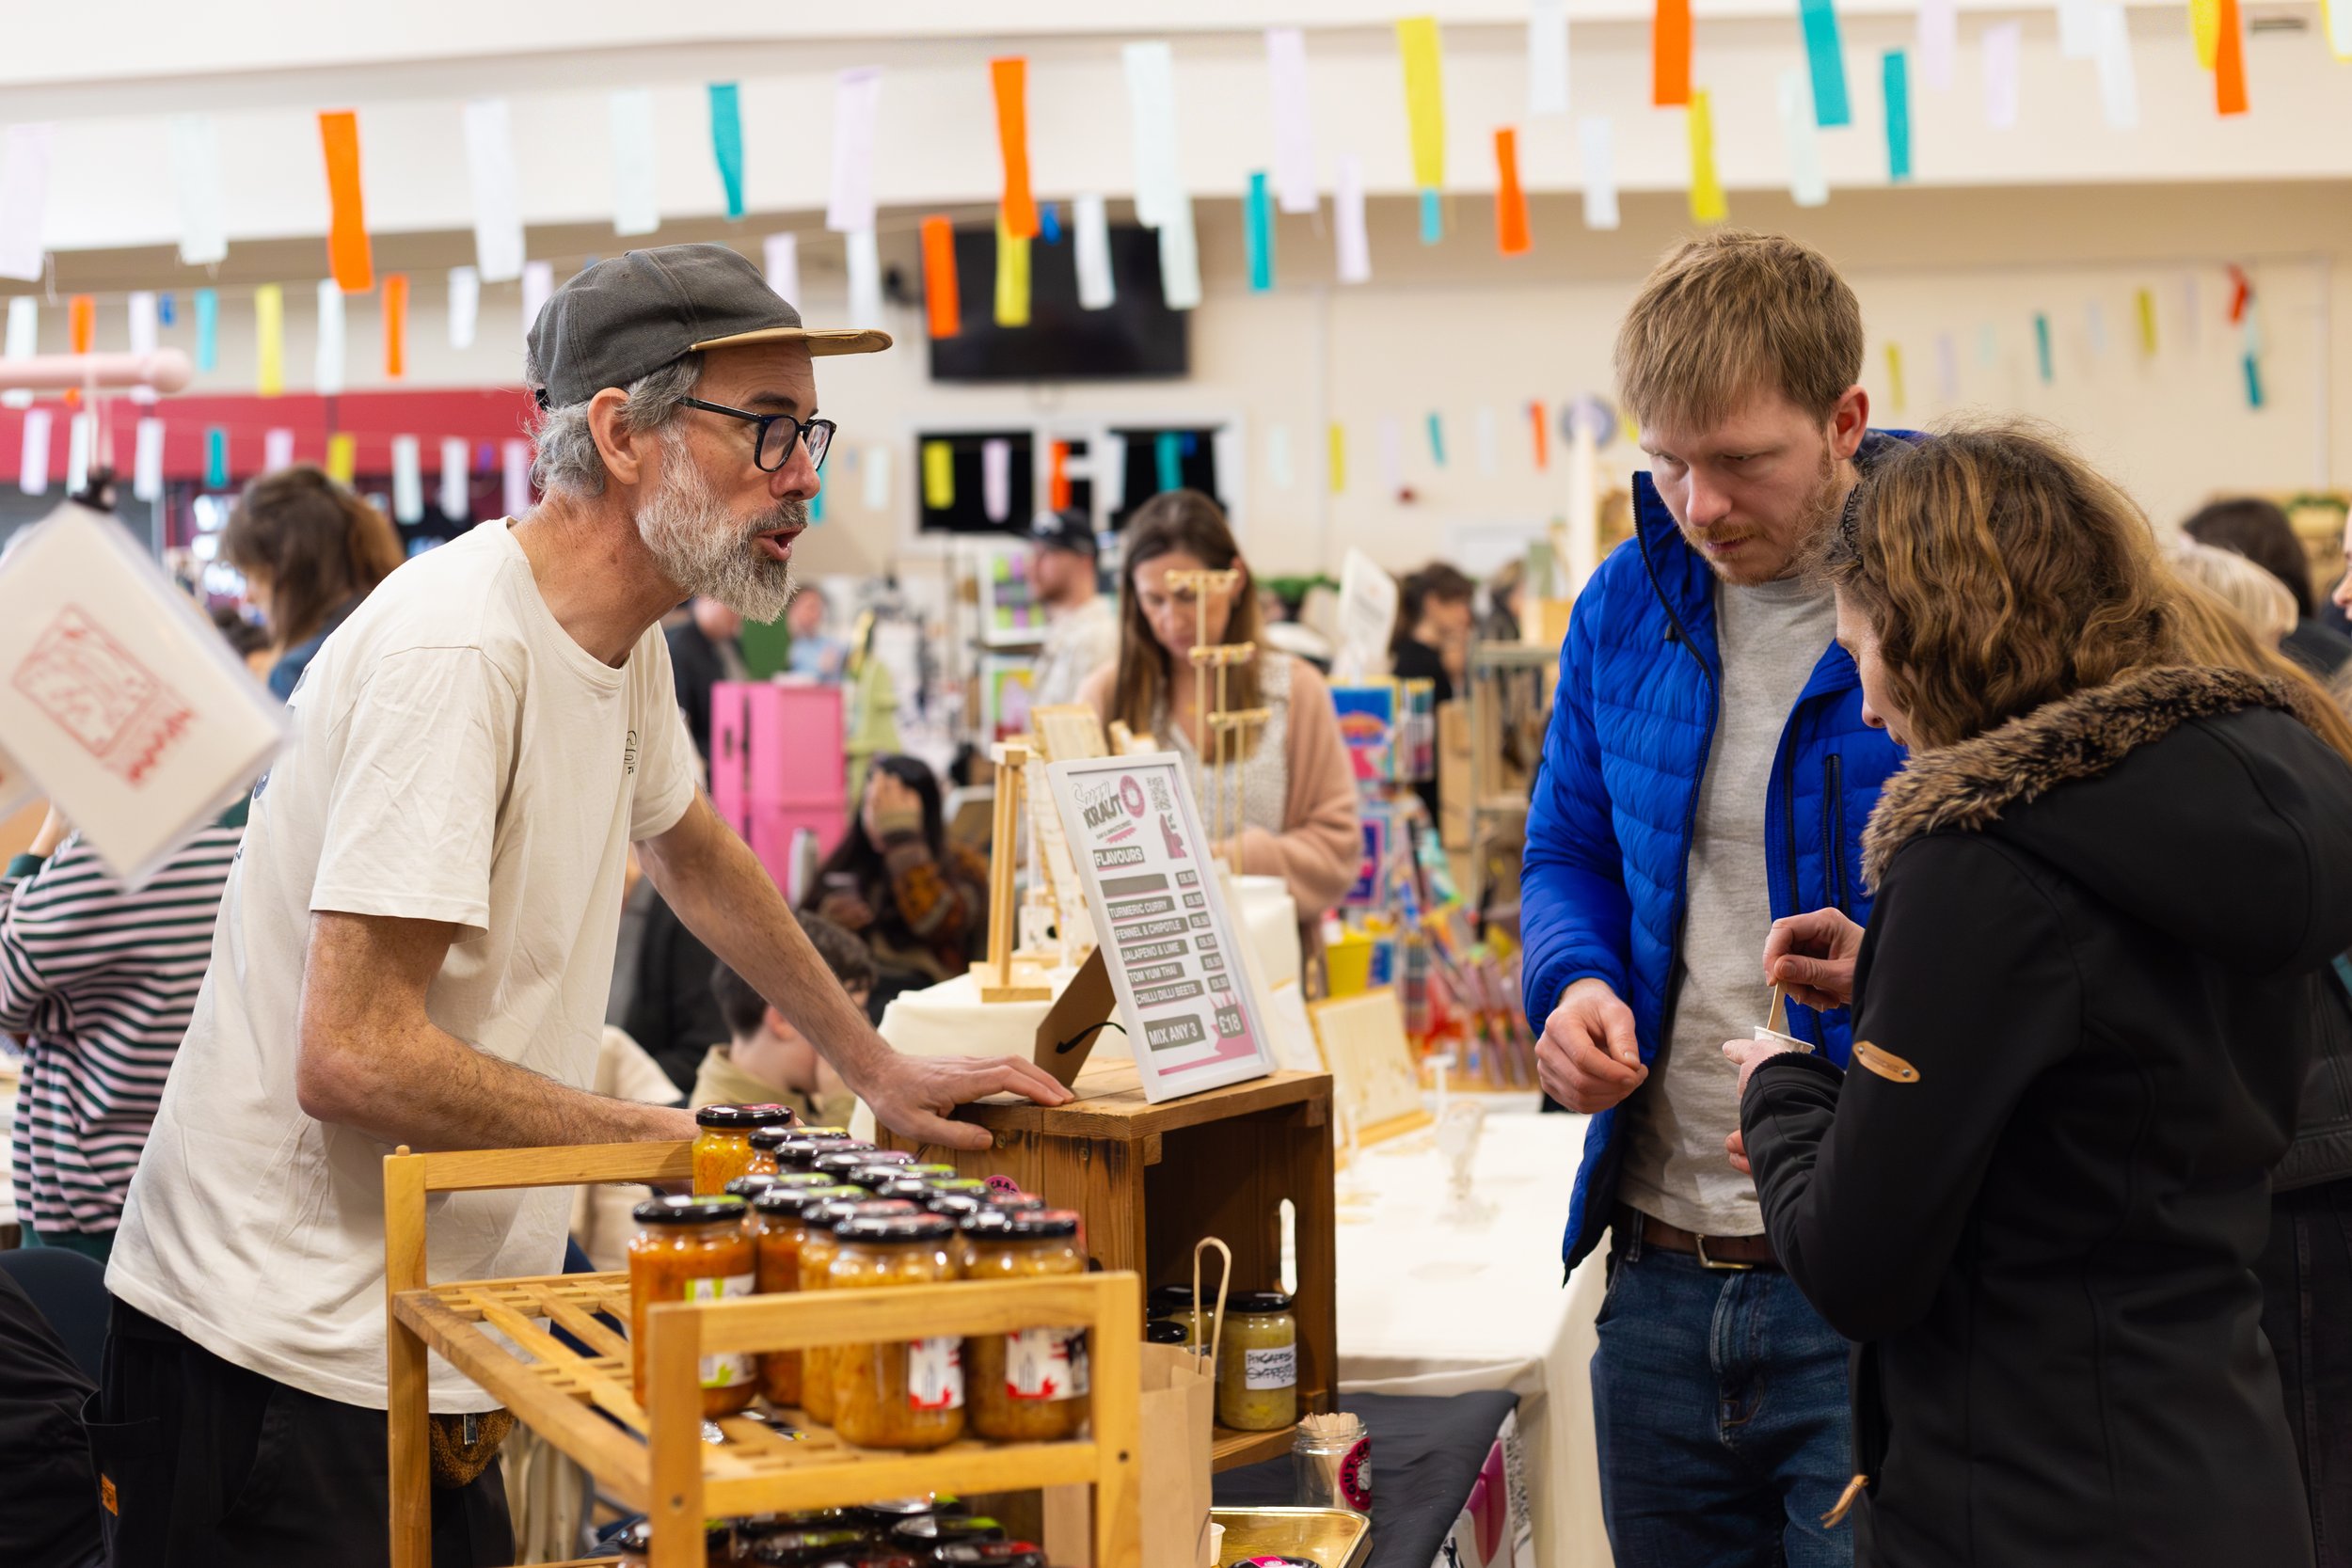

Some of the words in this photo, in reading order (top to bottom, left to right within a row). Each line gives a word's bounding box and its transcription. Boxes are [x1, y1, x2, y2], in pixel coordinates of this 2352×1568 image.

[1083, 793, 1123, 829] KRAUT
[1094, 848, 1143, 866] FLAVOURS
[1109, 904, 1145, 918] TURMERIC
[1144, 900, 1168, 912] CURRY
[1116, 927, 1142, 940] FENNEL
[1148, 920, 1182, 933] CHIPOTLE
[1163, 942, 1181, 954] LIME
[1128, 971, 1145, 983] TOM
[1144, 968, 1161, 979] YUM
[1161, 964, 1178, 976] THAI
[1136, 991, 1157, 1005] CHILLI
[1175, 984, 1197, 996] BEETS
[1218, 1013, 1242, 1033] £18
[1149, 1028, 1169, 1046] MIX
[1169, 1024, 1189, 1040] ANY
[1189, 1022, 1199, 1037] 3
